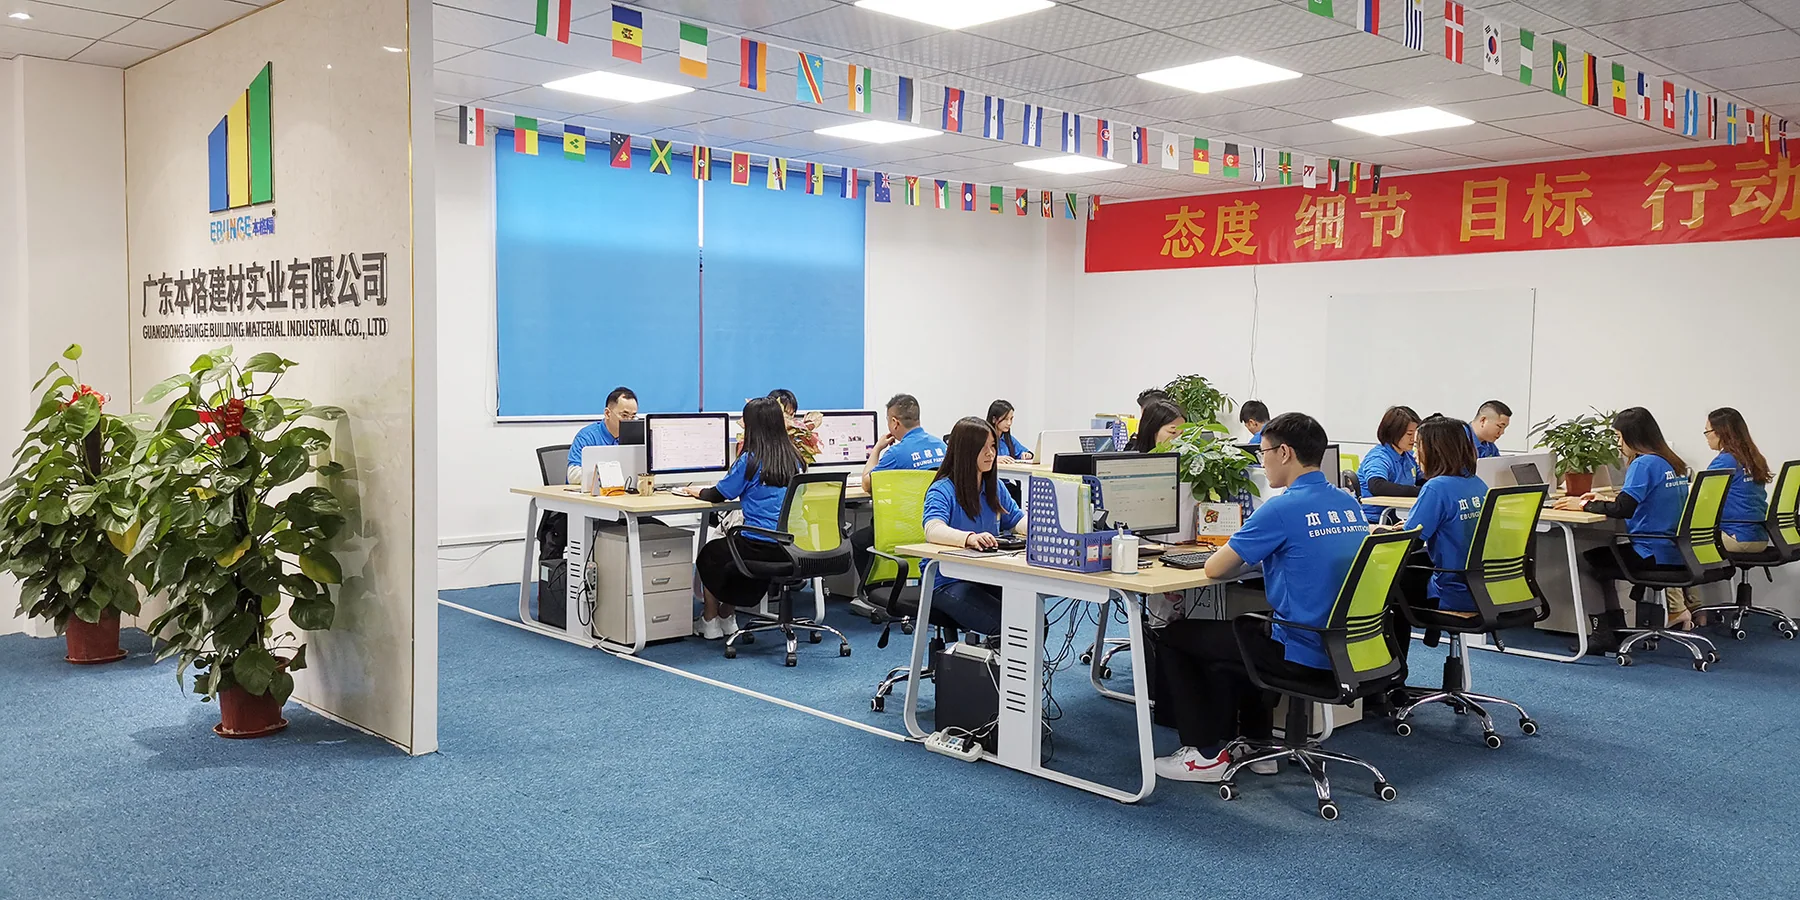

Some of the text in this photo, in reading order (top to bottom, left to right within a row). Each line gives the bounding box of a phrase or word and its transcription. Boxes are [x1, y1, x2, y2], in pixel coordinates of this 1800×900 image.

[1160, 151, 1800, 258] 态度 细节 目标 行动
[210, 216, 251, 242] EBUNGE
[142, 252, 388, 317] 广东本格建材实业有限公司
[142, 324, 184, 339] GUANGDONG
[184, 323, 209, 338] BUNGE
[209, 321, 244, 338] BUILDING
[245, 320, 285, 337] MATERIAL
[287, 319, 343, 337] INDUSTRIAL
[1309, 526, 1341, 538] EBUNGE
